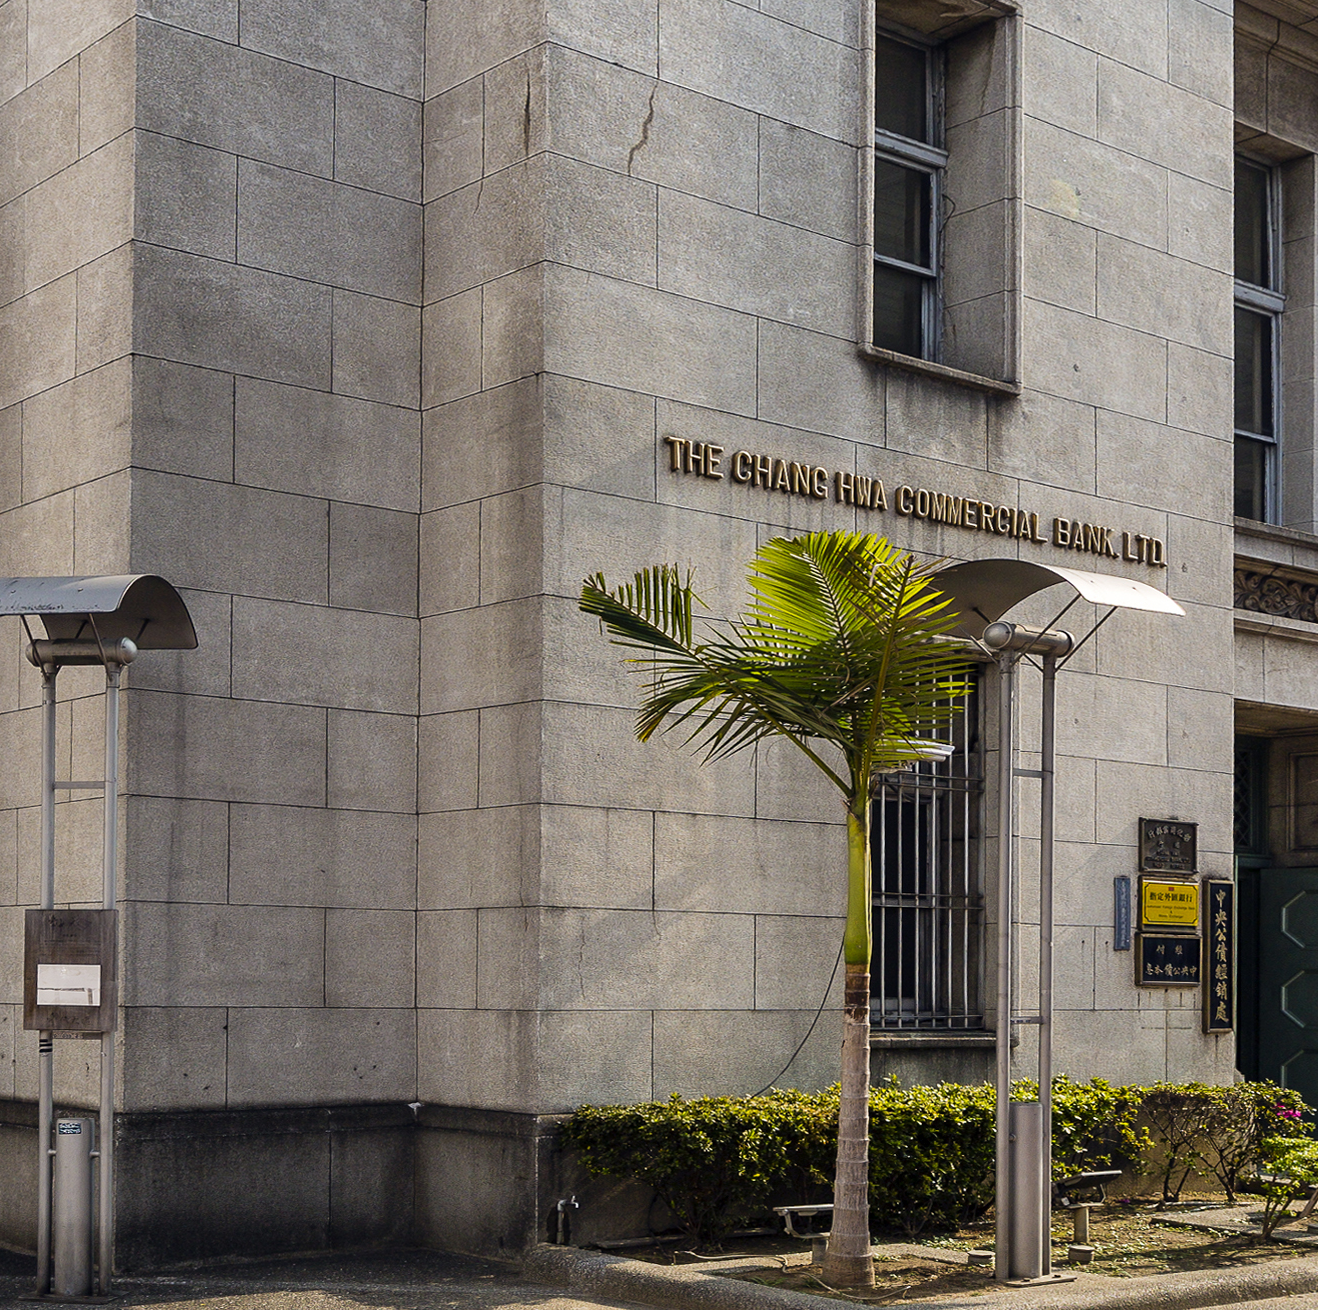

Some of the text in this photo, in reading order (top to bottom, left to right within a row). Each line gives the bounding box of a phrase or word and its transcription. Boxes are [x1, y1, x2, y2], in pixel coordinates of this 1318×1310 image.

[663, 435, 724, 479] THE
[731, 449, 830, 500] CHANG
[835, 470, 888, 511] HWA
[894, 484, 1049, 544] COMMERCIAL
